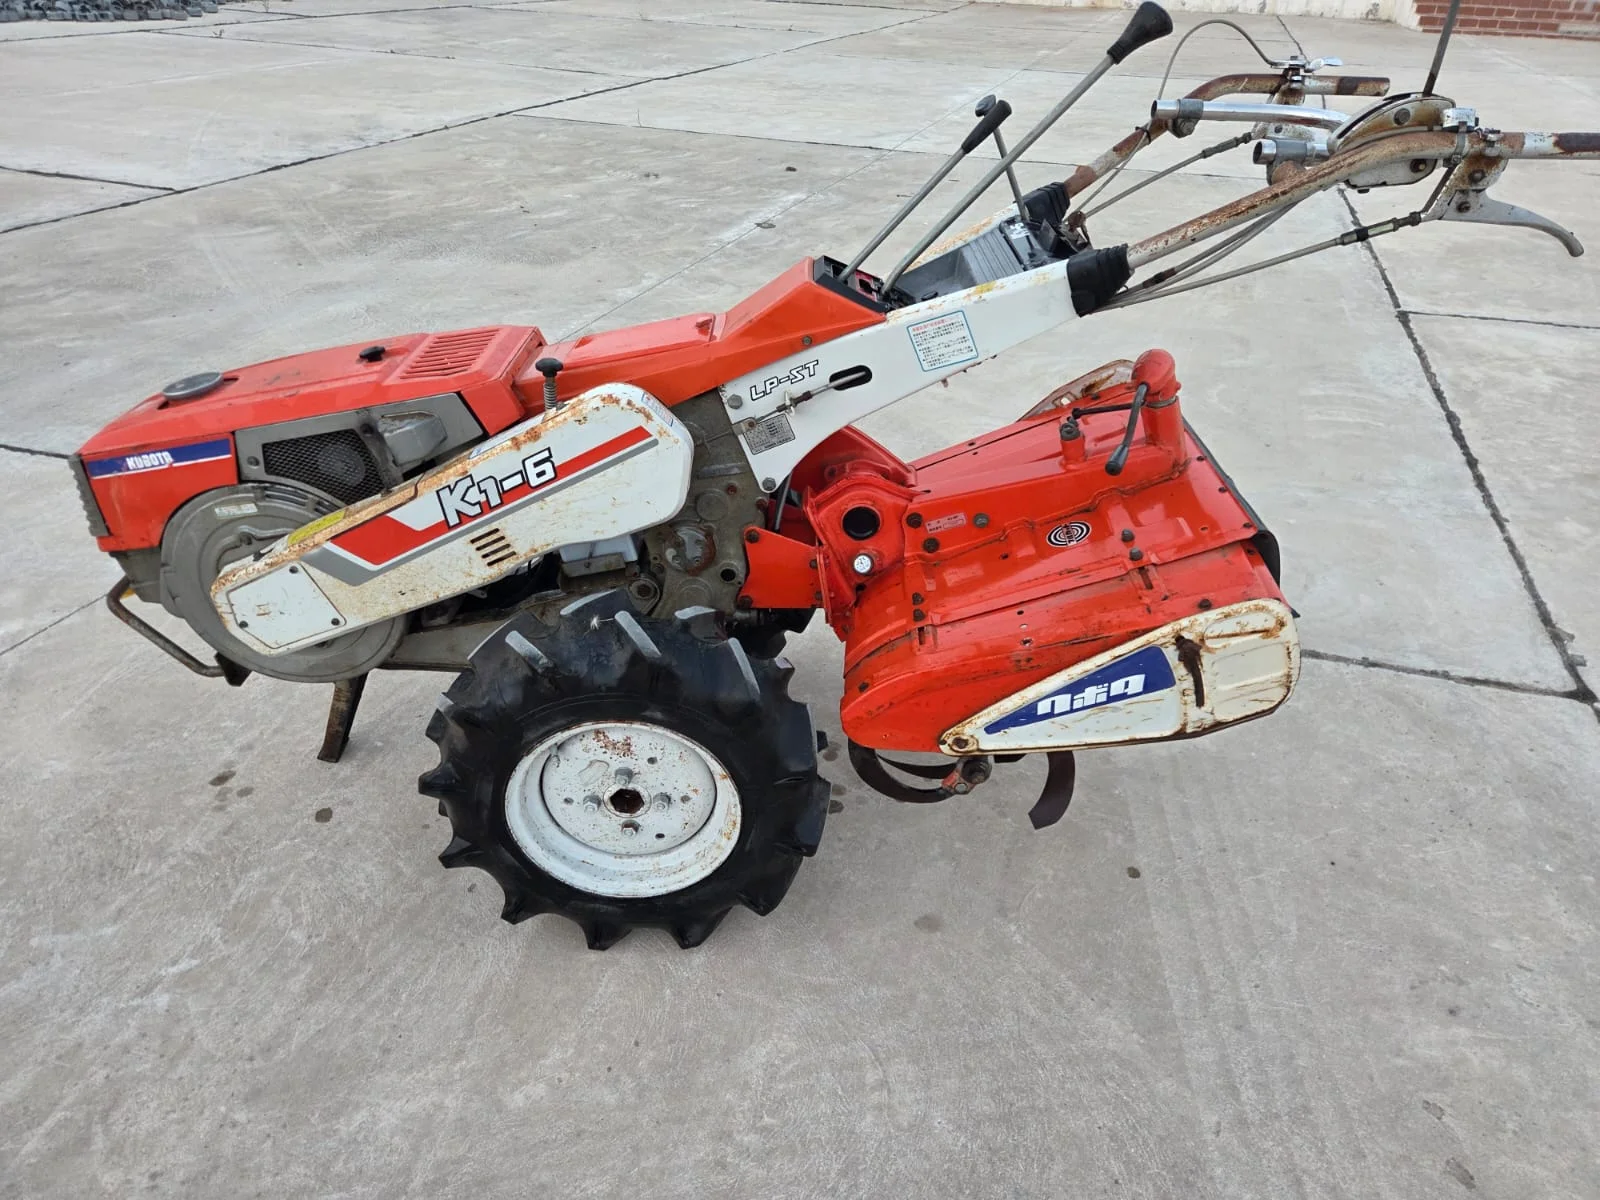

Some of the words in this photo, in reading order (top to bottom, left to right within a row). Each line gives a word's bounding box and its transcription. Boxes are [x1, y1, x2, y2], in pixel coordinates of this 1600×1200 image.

[750, 360, 819, 401] LP-ST
[126, 450, 174, 470] KUBOTA
[436, 447, 557, 528] K1-6
